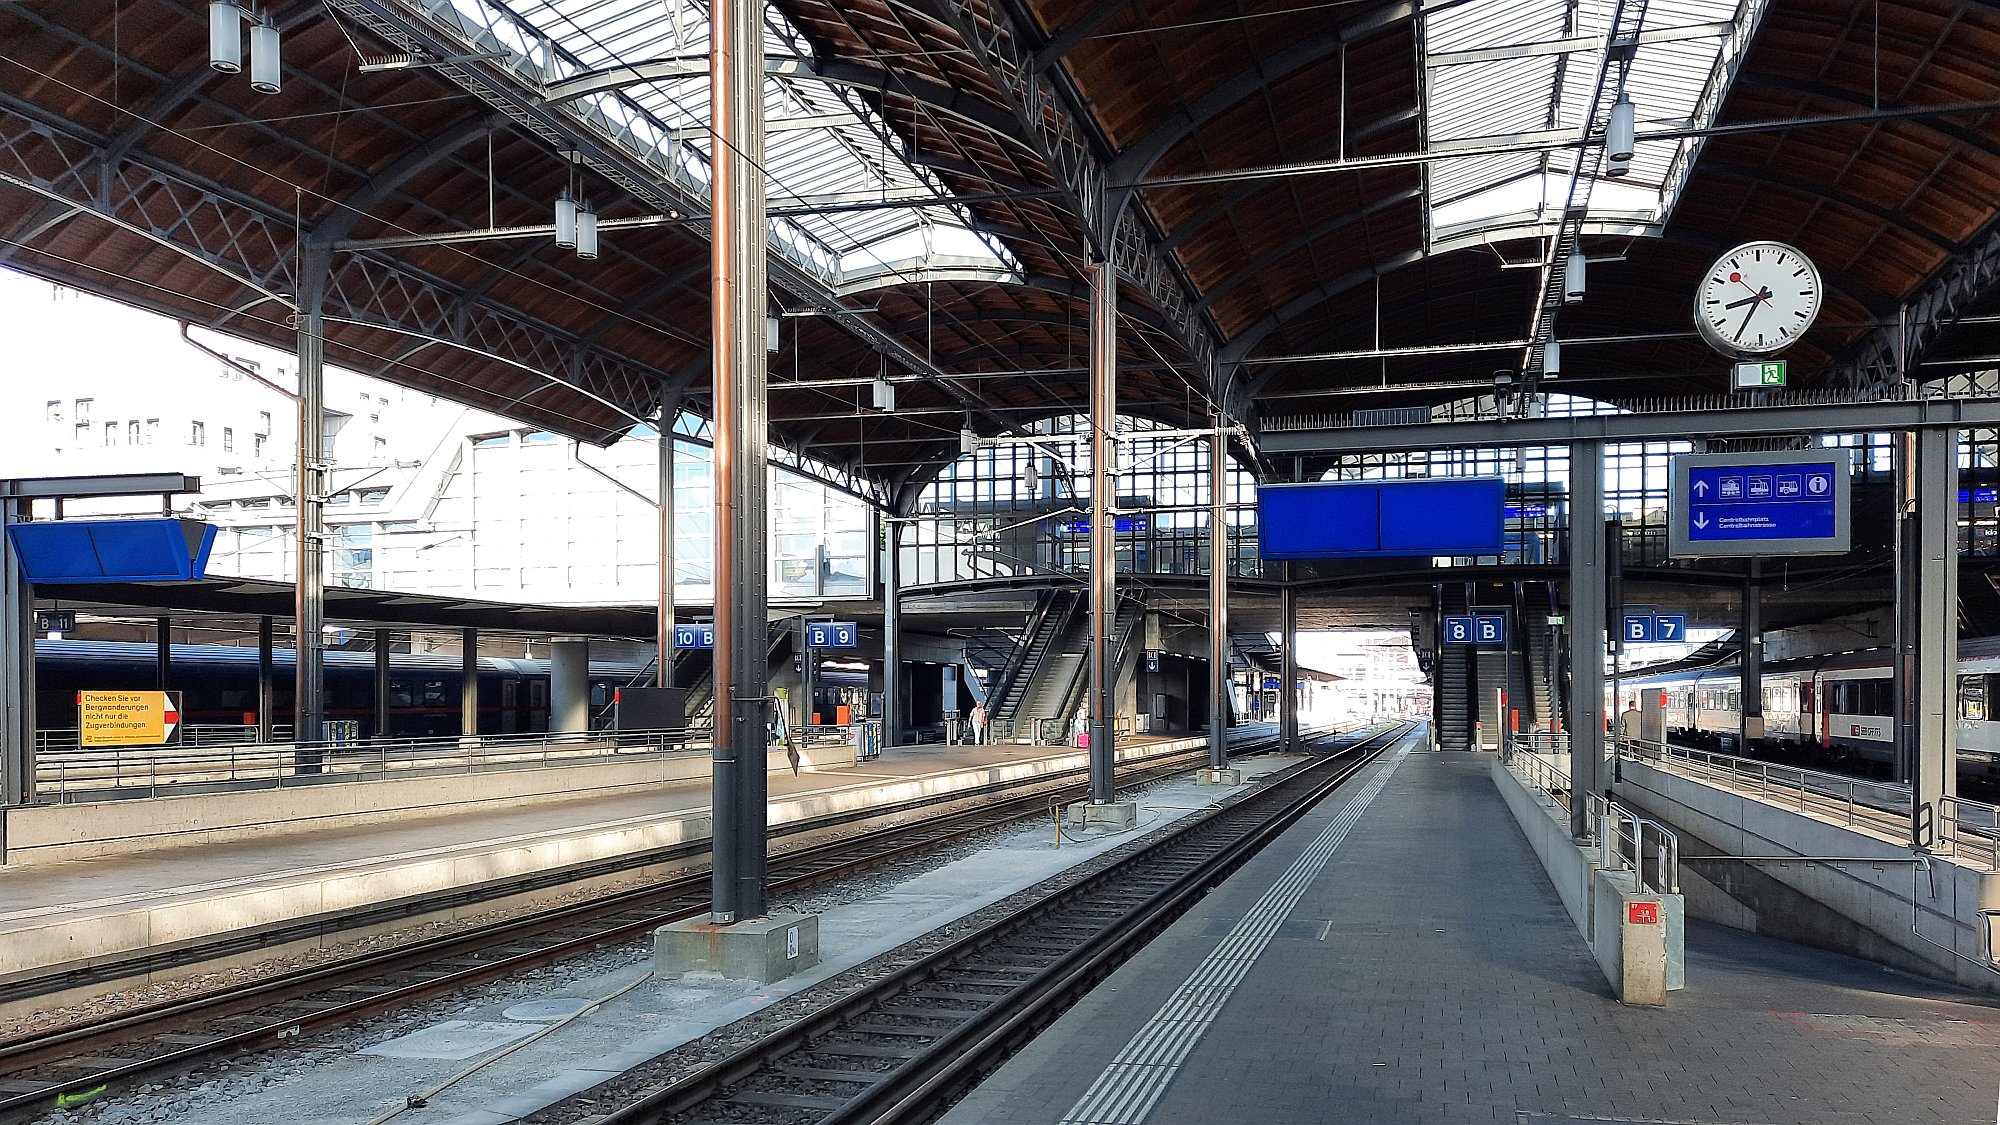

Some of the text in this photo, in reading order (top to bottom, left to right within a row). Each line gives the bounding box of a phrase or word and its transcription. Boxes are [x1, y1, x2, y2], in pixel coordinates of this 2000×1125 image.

[42, 618, 68, 629] B 11
[814, 630, 848, 644] B 9
[1454, 624, 1496, 639] 8 B
[1632, 624, 1676, 638] B 7
[678, 632, 713, 644] 10 B
[86, 722, 147, 730] Zugverbindungen.
